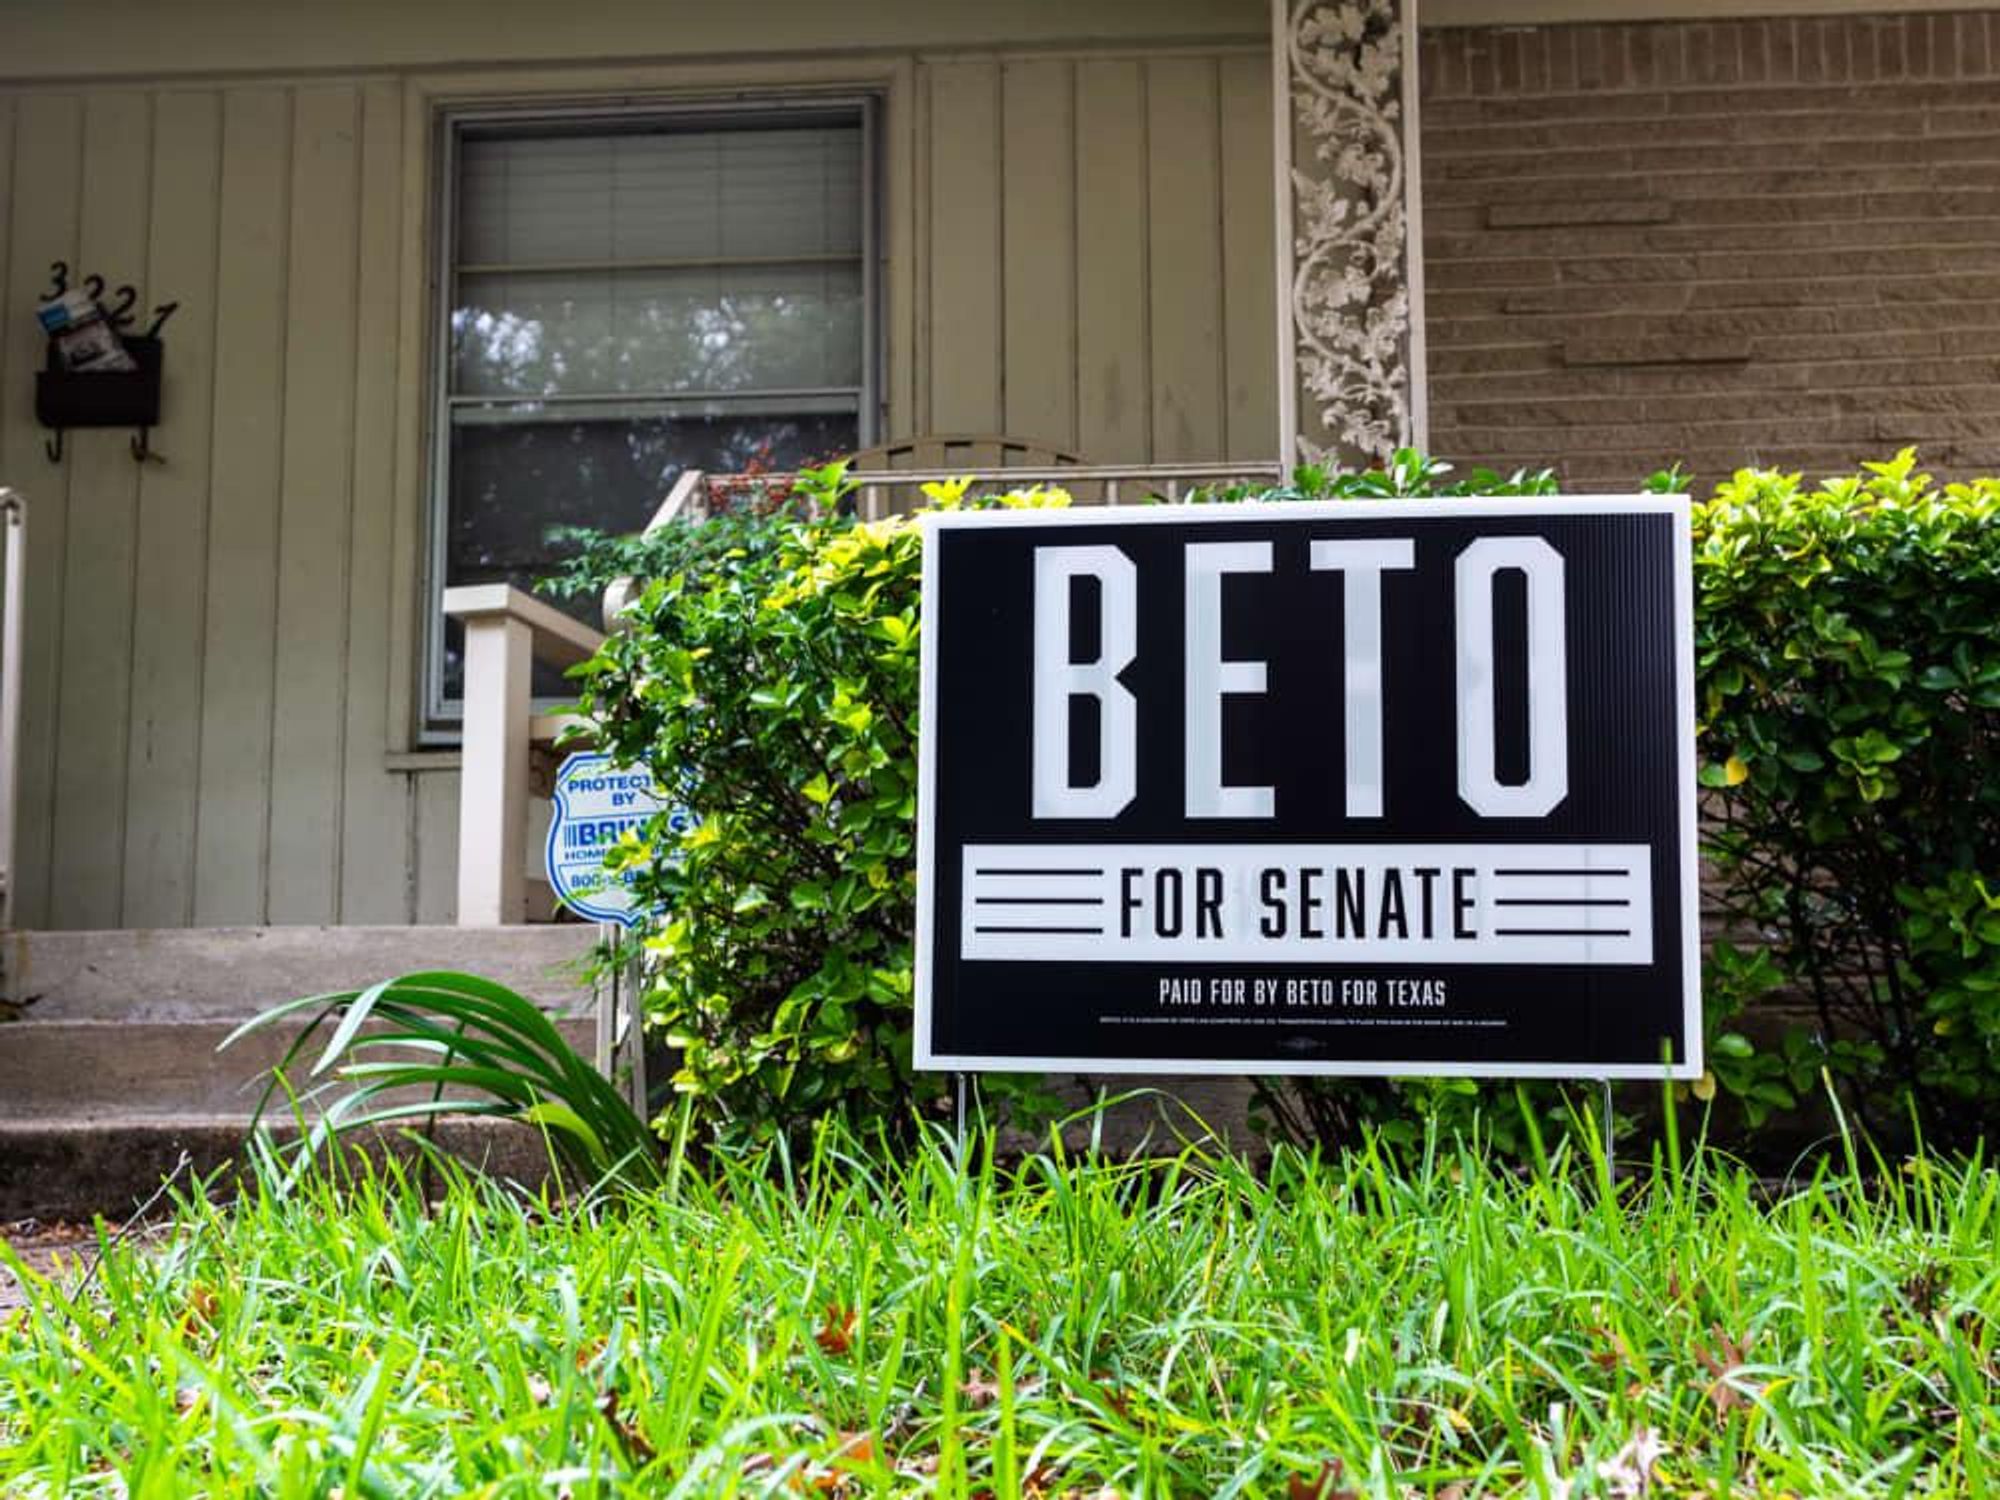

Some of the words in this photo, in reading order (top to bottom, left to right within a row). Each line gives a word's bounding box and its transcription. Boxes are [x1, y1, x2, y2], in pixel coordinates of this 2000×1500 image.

[1032, 535, 1569, 819] BETO
[568, 775, 651, 793] PROTECT
[611, 792, 636, 807] BY
[1121, 867, 1224, 939] FOR
[1260, 867, 1478, 940] SENATE
[1159, 978, 1201, 1005] PAID
[1210, 978, 1246, 1005] FOR
[1254, 978, 1278, 1005] BY
[1286, 978, 1334, 1006] BETO
[1341, 979, 1378, 1006] FOR
[1385, 979, 1447, 1007] TEXAS
